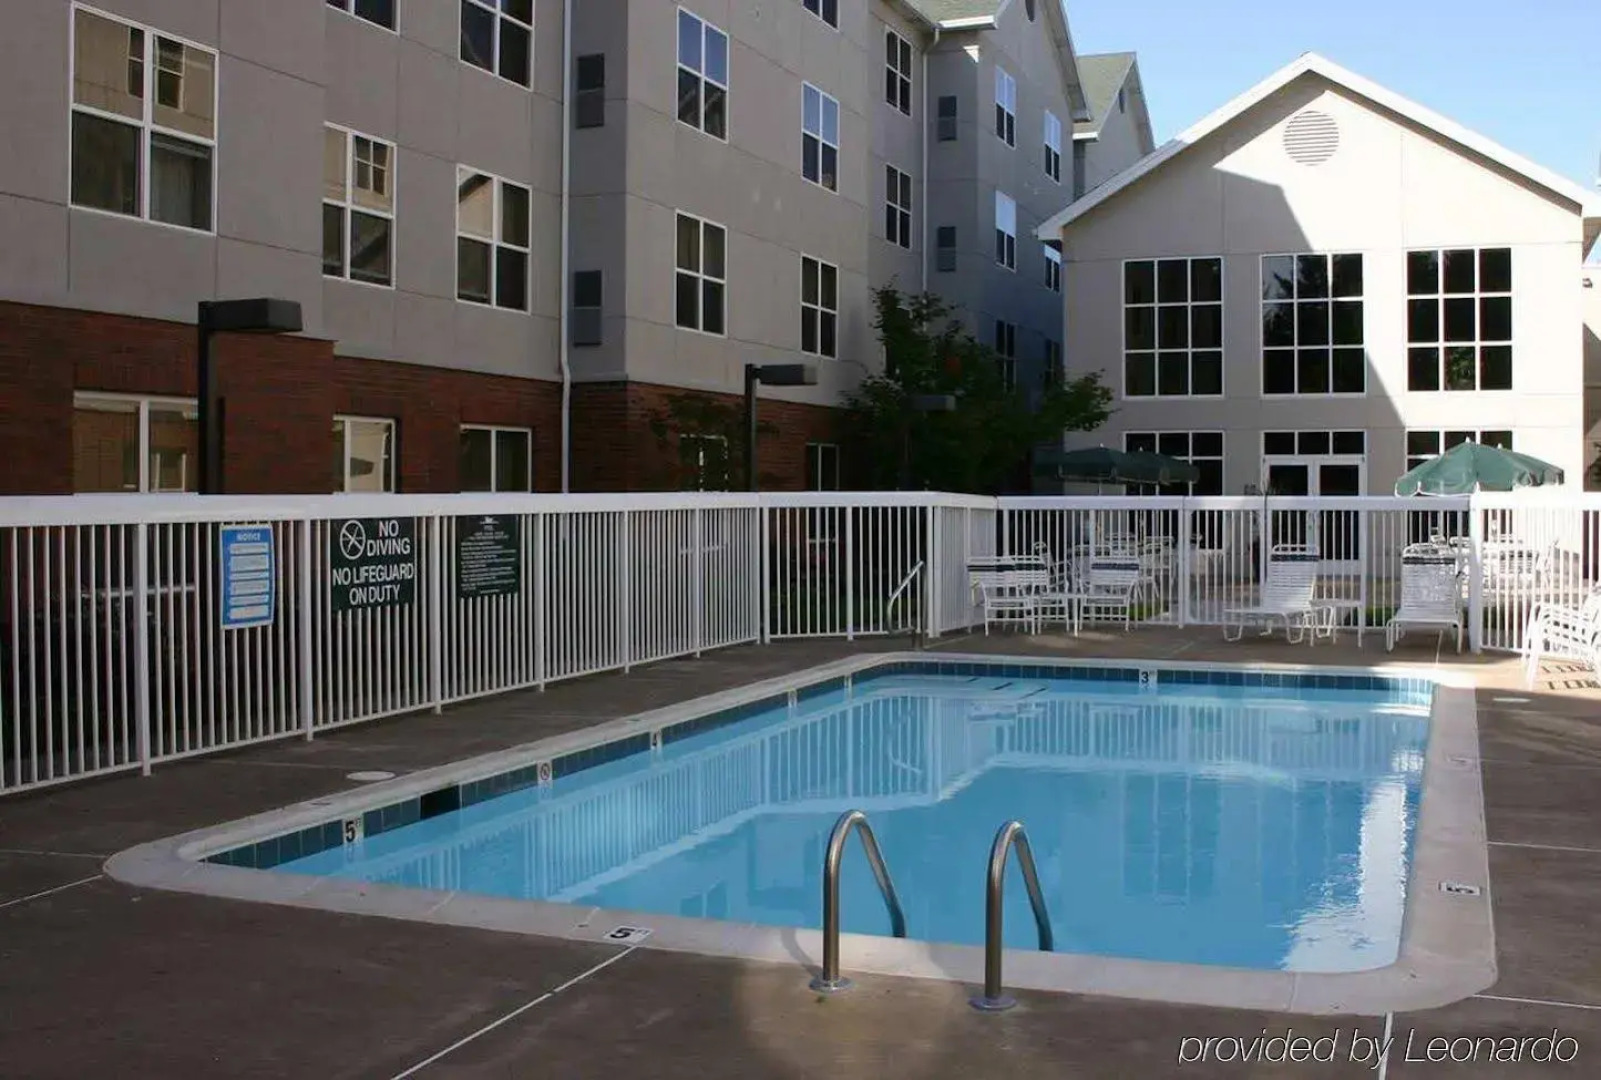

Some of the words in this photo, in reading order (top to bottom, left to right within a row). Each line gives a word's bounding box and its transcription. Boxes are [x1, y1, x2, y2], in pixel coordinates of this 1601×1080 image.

[379, 520, 399, 538] NO
[367, 537, 411, 557] DIVING
[332, 567, 351, 586] NO
[353, 563, 414, 584] LIFEGUARD
[349, 587, 367, 606] ON
[368, 584, 401, 603] DUTY
[1141, 671, 1149, 684] 3
[345, 820, 356, 843] 5
[610, 927, 635, 939] 5
